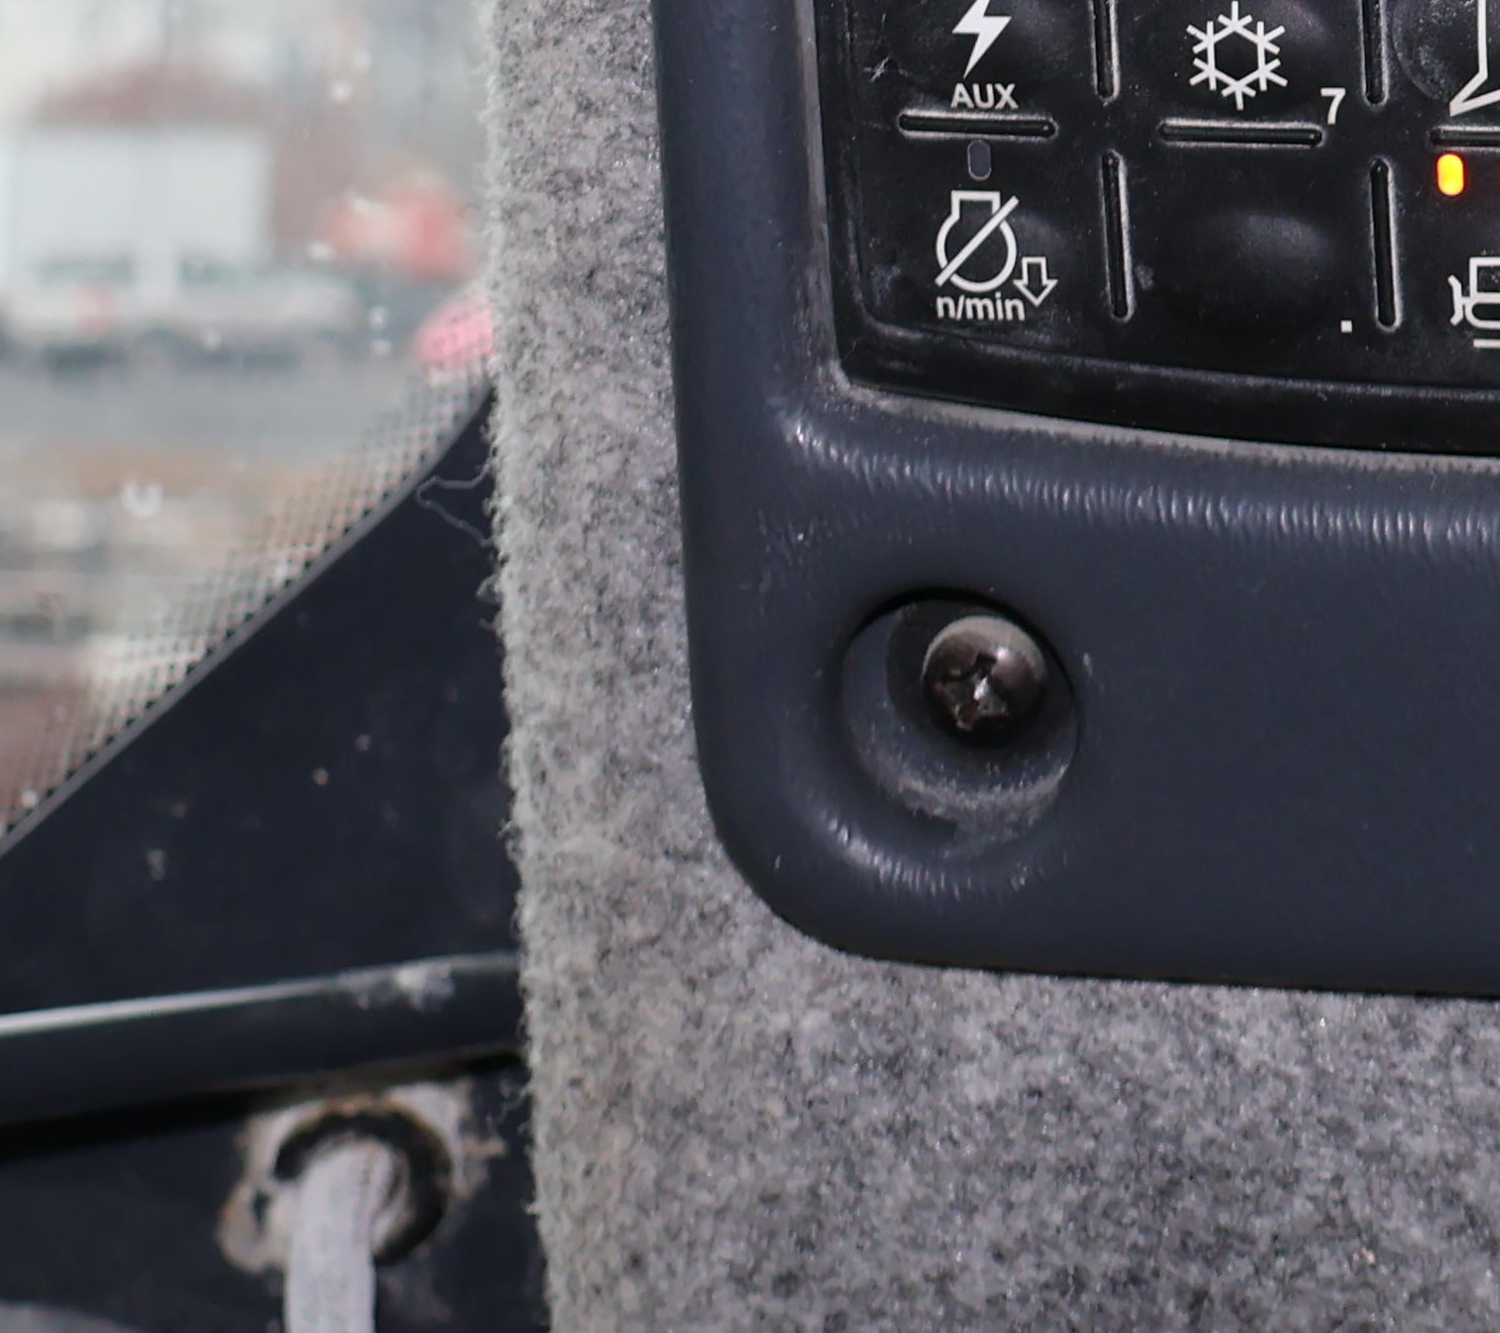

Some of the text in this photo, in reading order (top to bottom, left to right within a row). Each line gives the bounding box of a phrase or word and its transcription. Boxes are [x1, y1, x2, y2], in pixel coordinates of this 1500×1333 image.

[950, 83, 1018, 109] AUX
[1320, 87, 1346, 124] 7
[935, 292, 1026, 322] n/min
